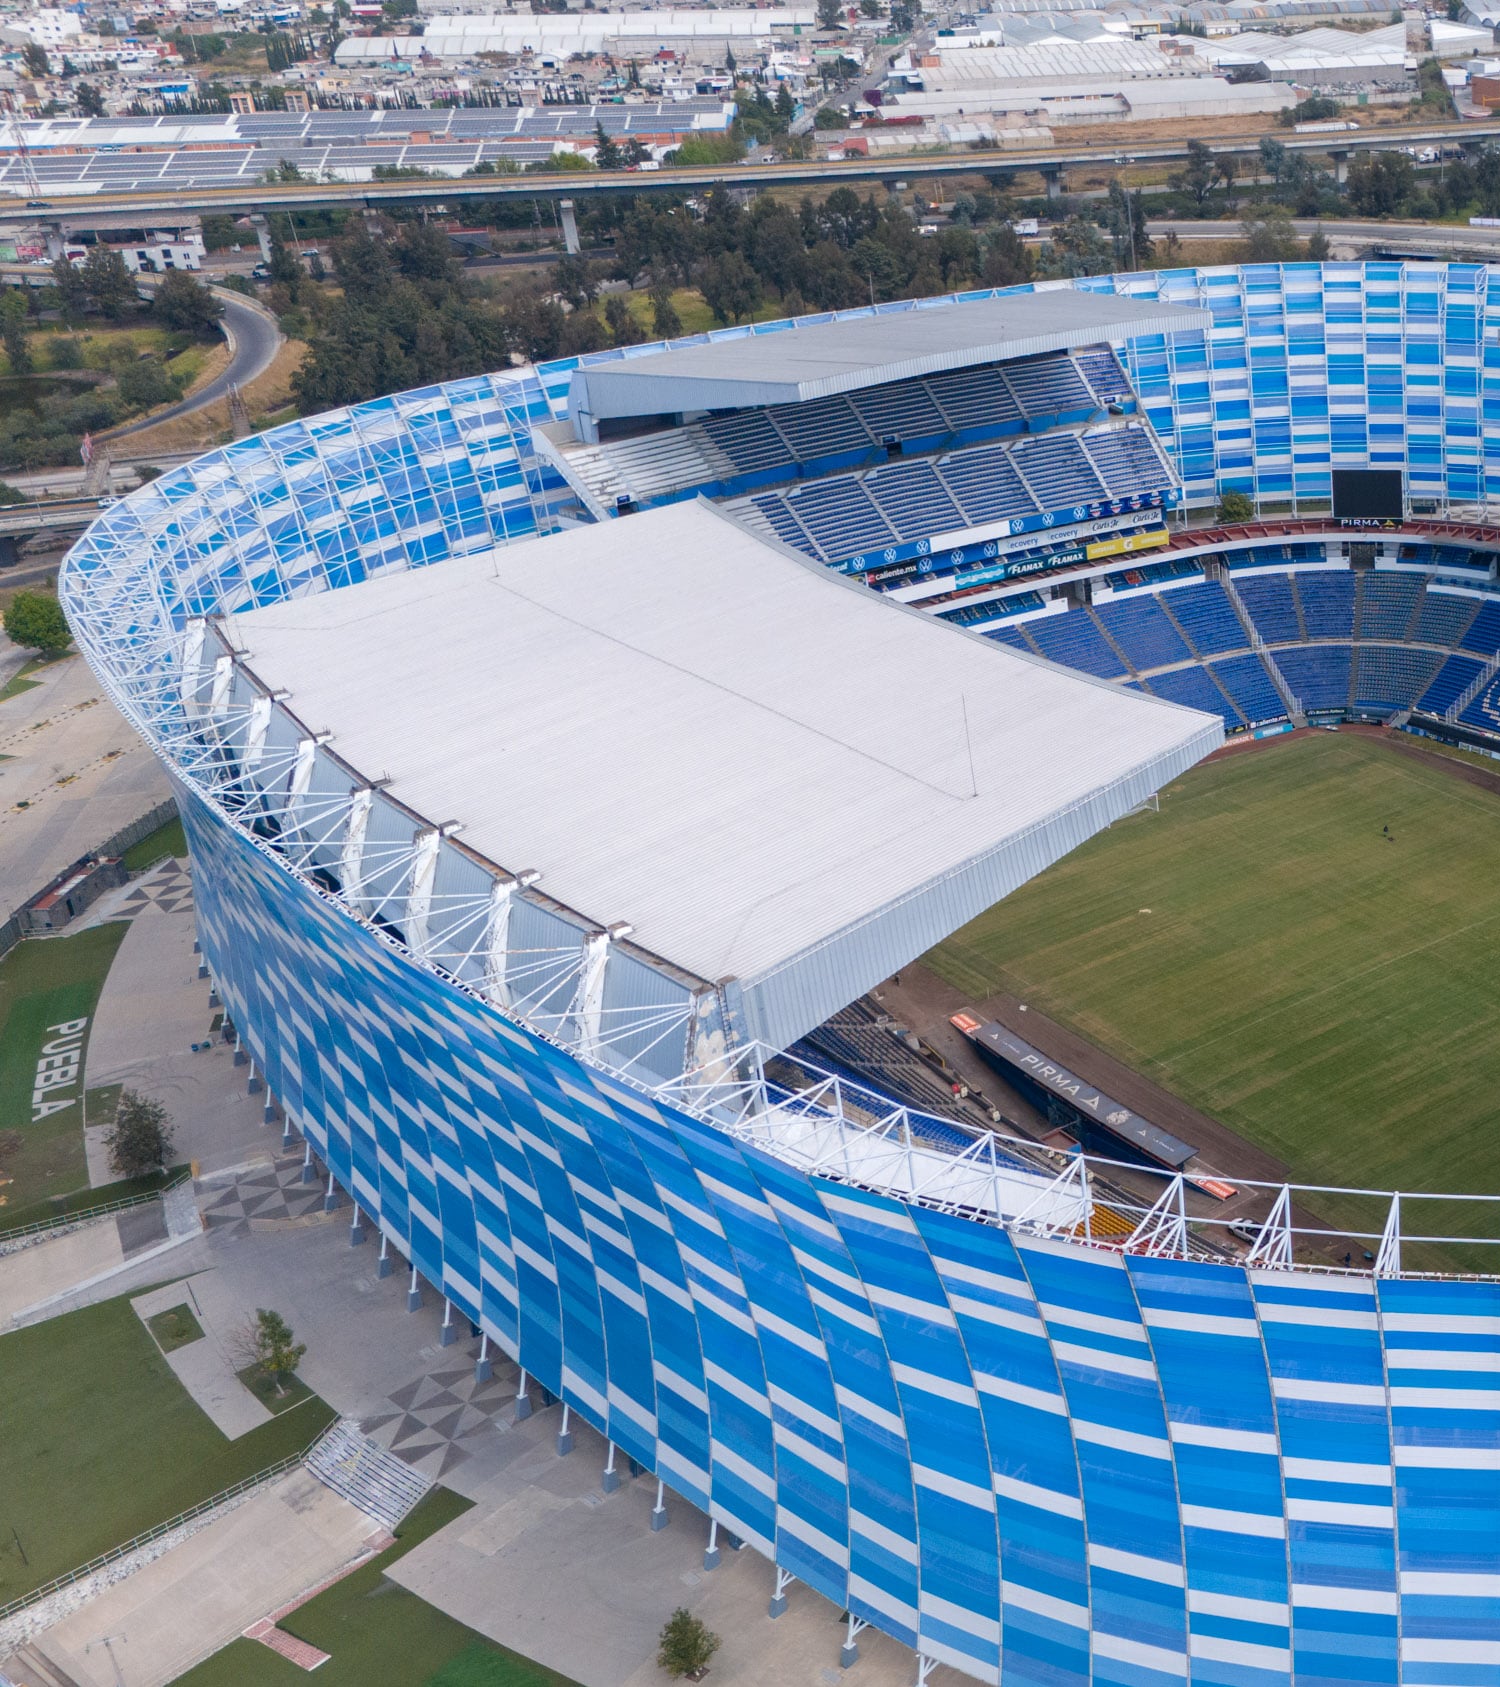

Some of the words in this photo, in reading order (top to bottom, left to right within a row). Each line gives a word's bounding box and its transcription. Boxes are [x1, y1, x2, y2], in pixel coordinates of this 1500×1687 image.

[1052, 552, 1084, 566] FLANAX
[875, 565, 917, 580] caliente.mx
[1011, 561, 1044, 575] FLANAX
[31, 1017, 88, 1122] PUEBLA
[1020, 1054, 1081, 1096] PIRMA
